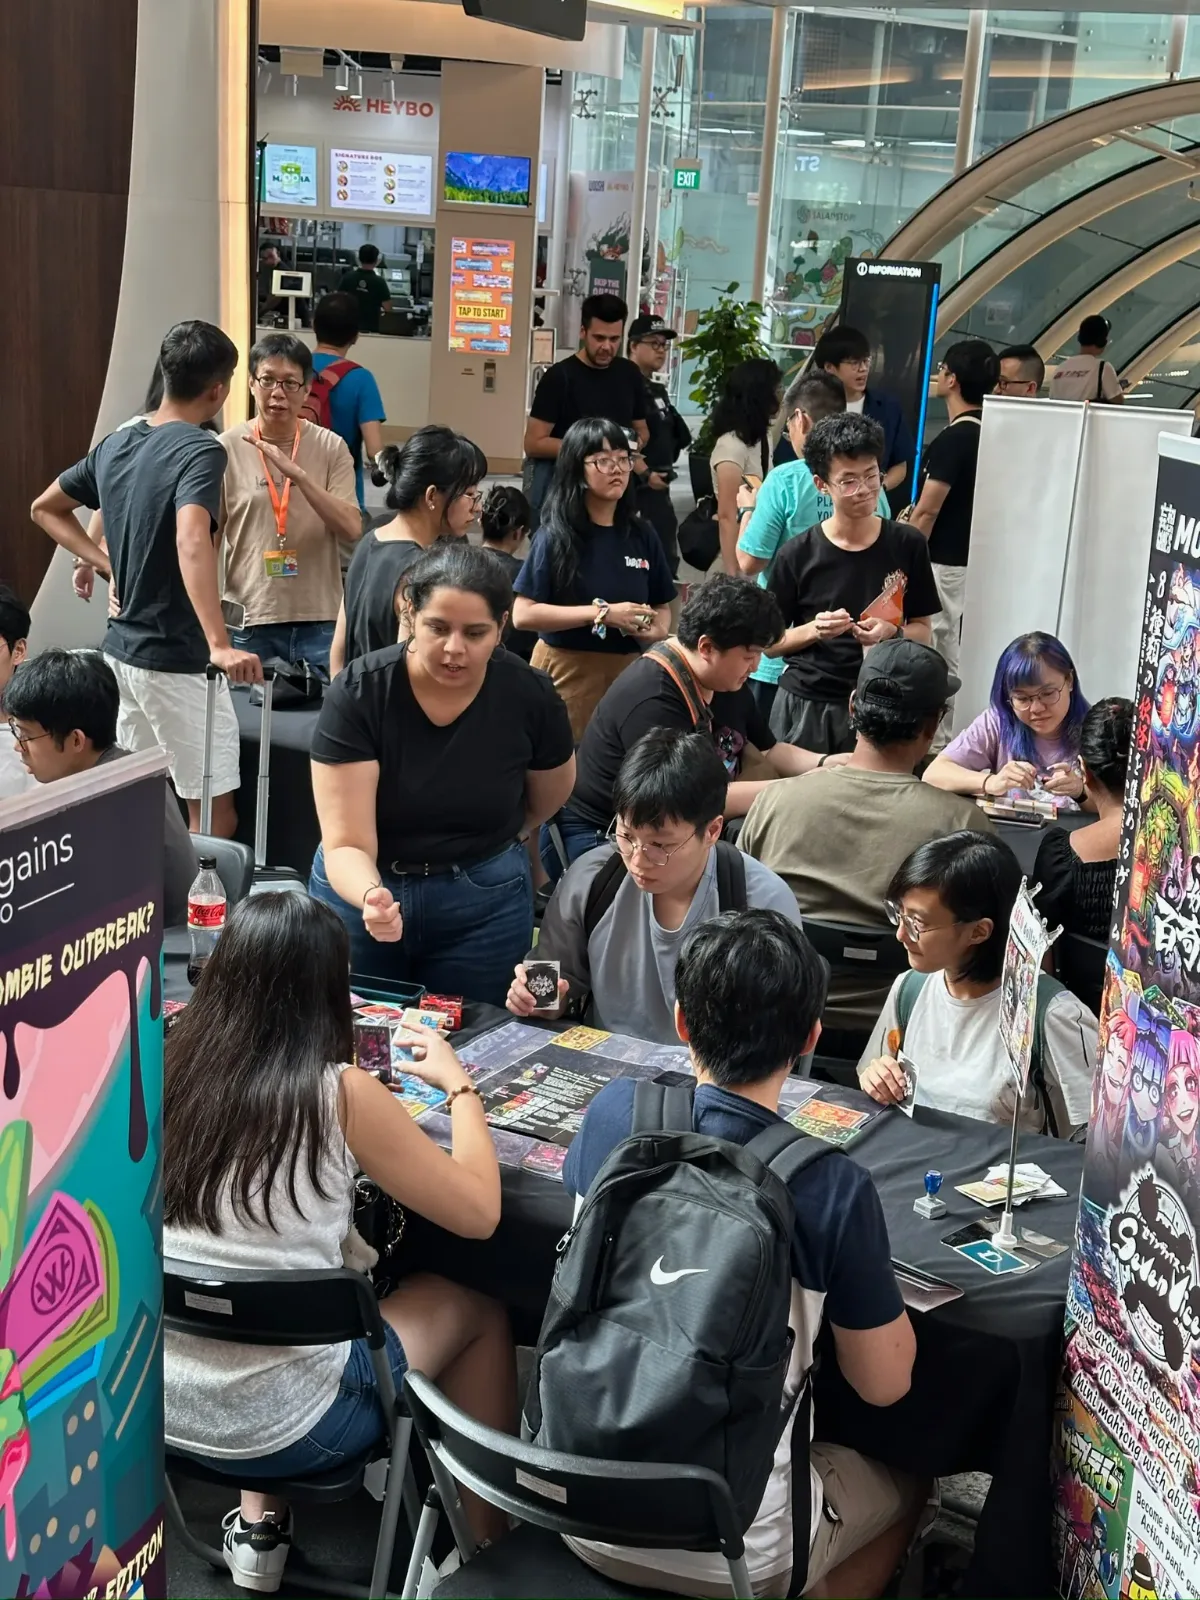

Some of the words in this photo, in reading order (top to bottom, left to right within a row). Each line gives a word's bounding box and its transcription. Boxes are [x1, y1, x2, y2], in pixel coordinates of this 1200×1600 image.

[366, 97, 433, 117] HEYBO
[677, 171, 696, 187] EXIT
[868, 264, 922, 278] INFORMATION
[458, 306, 471, 316] TAP
[473, 307, 481, 317] TO
[483, 308, 504, 319] START
[61, 901, 155, 977] OUTBREAK?
[1112, 1217, 1169, 1297] Seven
[1067, 1290, 1094, 1333] themed
[1094, 1331, 1130, 1373] around
[1132, 1365, 1149, 1395] the
[1150, 1390, 1177, 1428] seven
[1072, 1371, 1098, 1409] Mini
[1098, 1403, 1142, 1461] mahjong
[1142, 1454, 1167, 1489] with
[1099, 1365, 1112, 1384] 10
[1111, 1382, 1148, 1432] minute
[1149, 1425, 1186, 1478] match!
[1136, 1490, 1163, 1528] Become
[105, 1518, 164, 1600] EDITION
[1140, 1514, 1165, 1554] Action
[1165, 1549, 1185, 1581] panic
